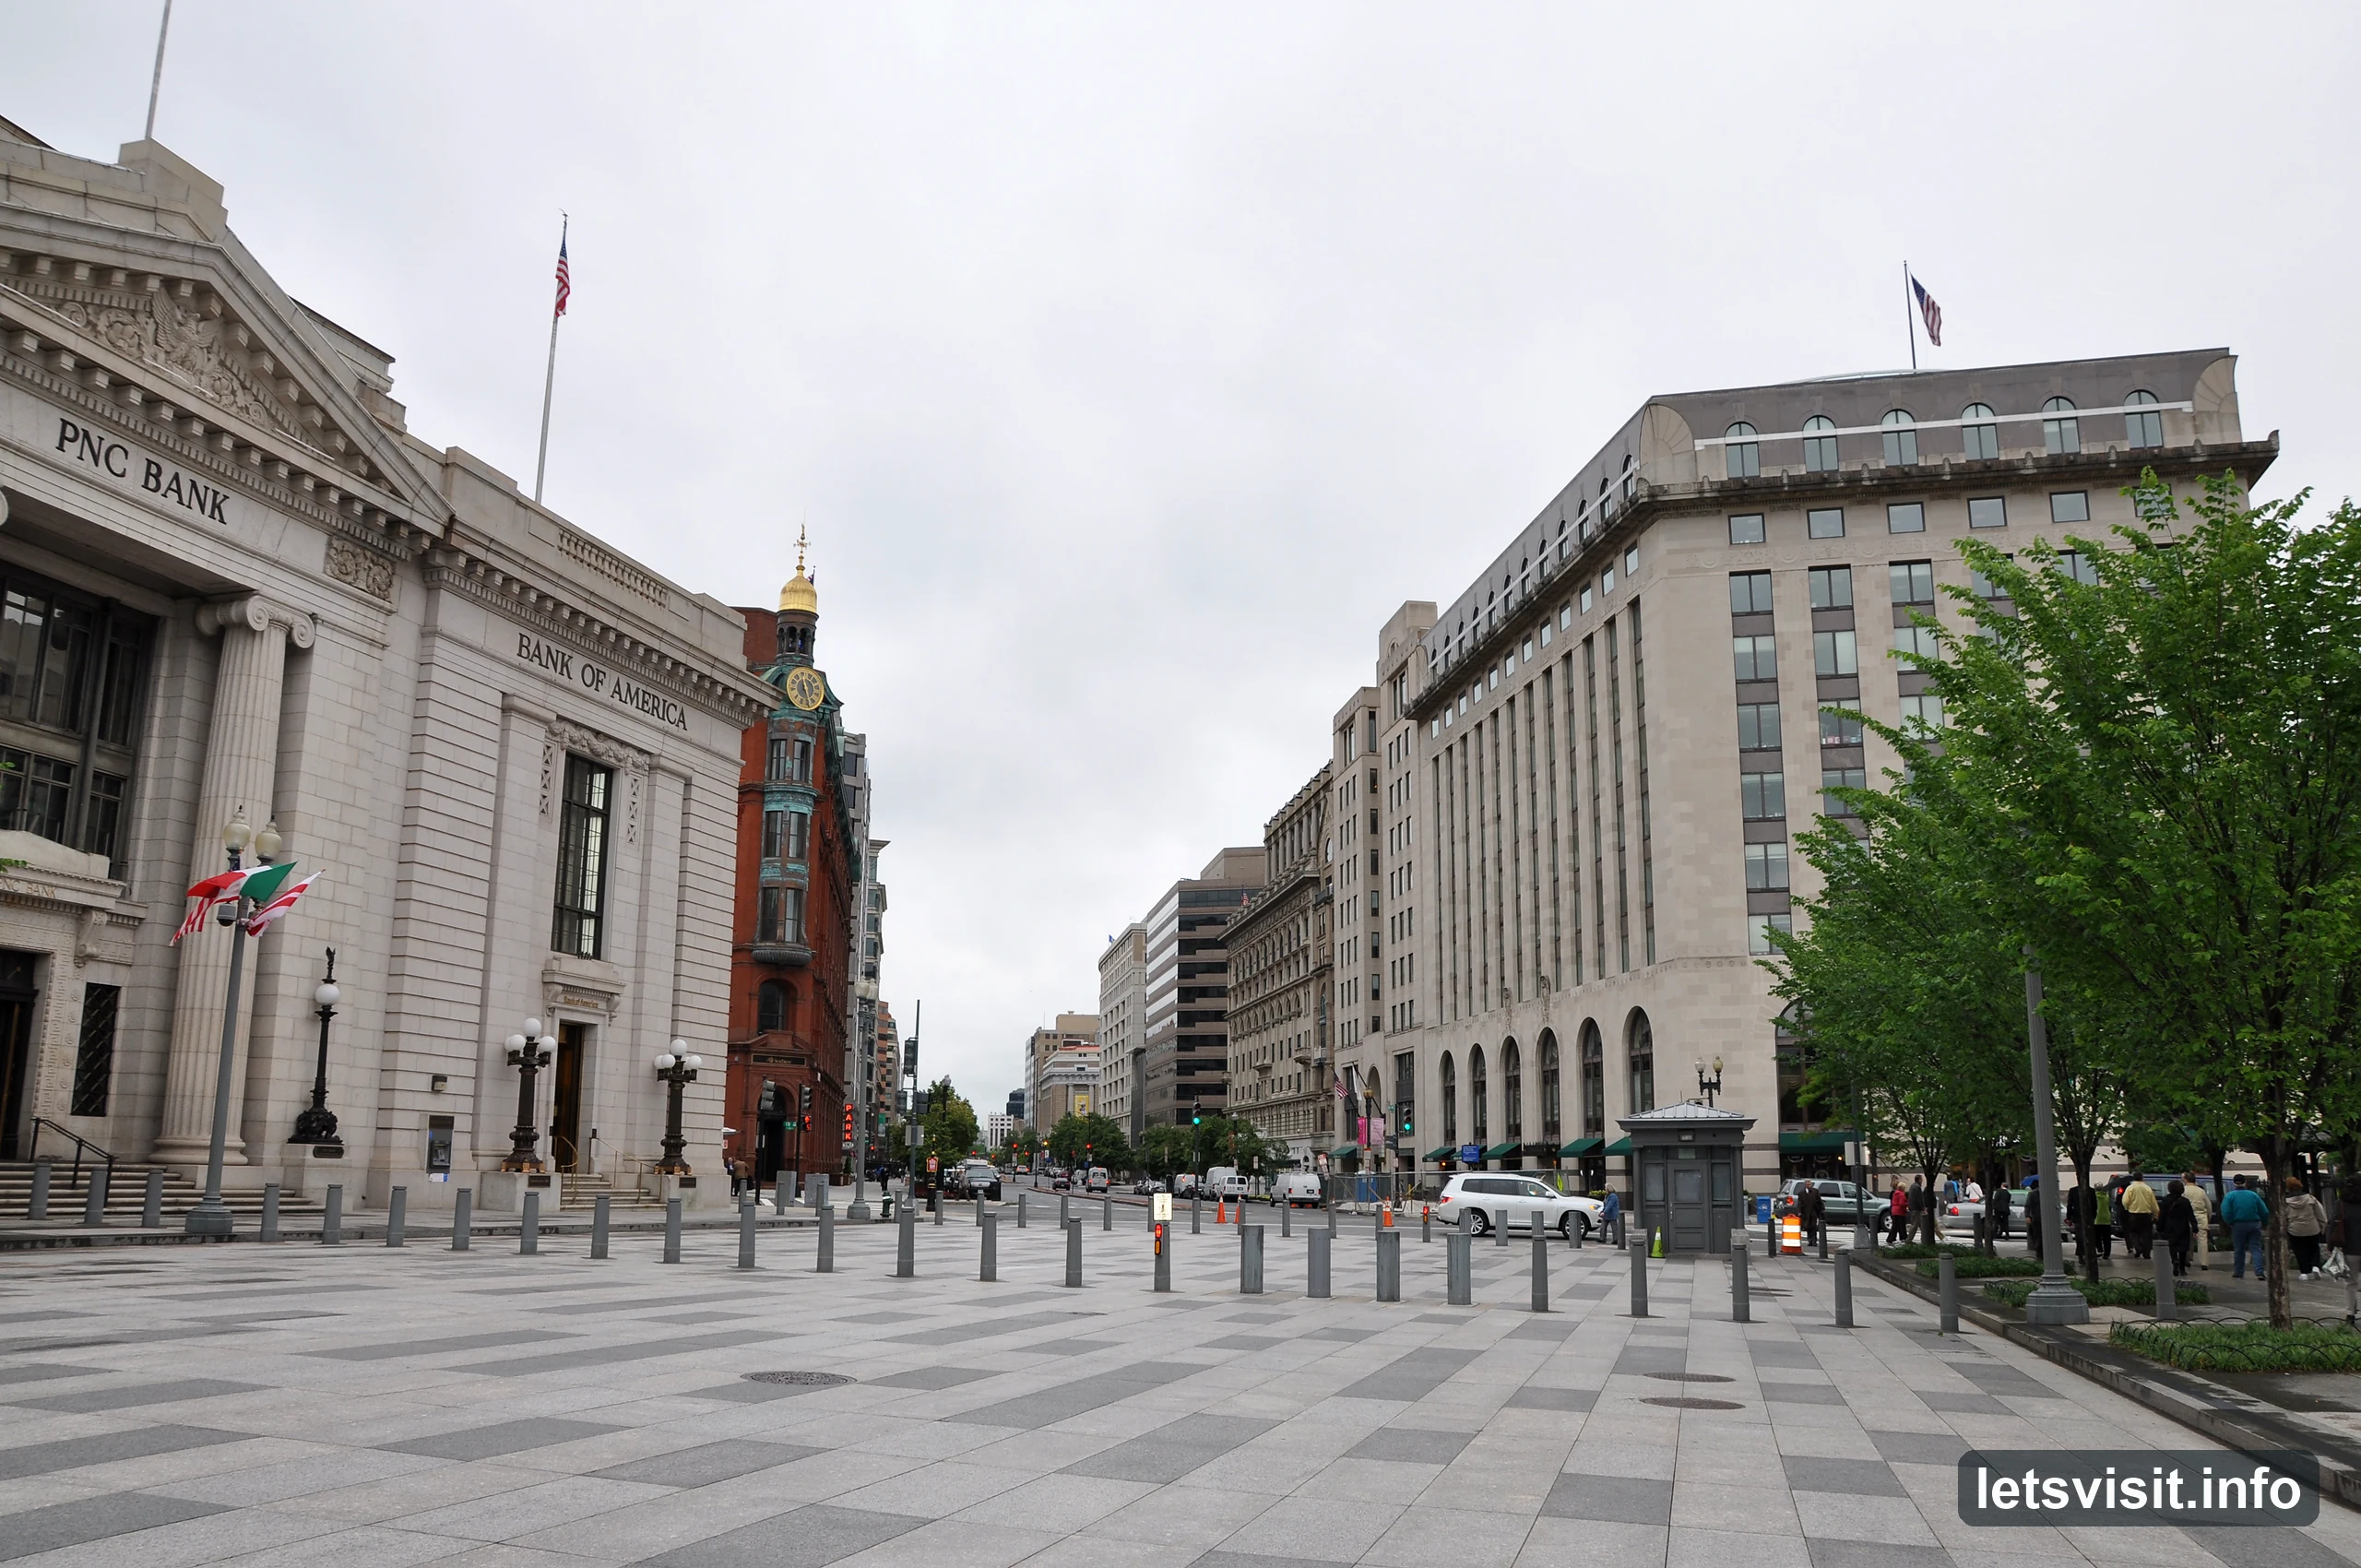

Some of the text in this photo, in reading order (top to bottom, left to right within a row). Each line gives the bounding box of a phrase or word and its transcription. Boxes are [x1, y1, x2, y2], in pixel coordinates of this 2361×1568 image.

[55, 418, 231, 526] PNC BANK
[516, 632, 689, 731] BANK OF AMERICA
[0, 878, 56, 898] NC BANK
[845, 1104, 853, 1140] PARK
